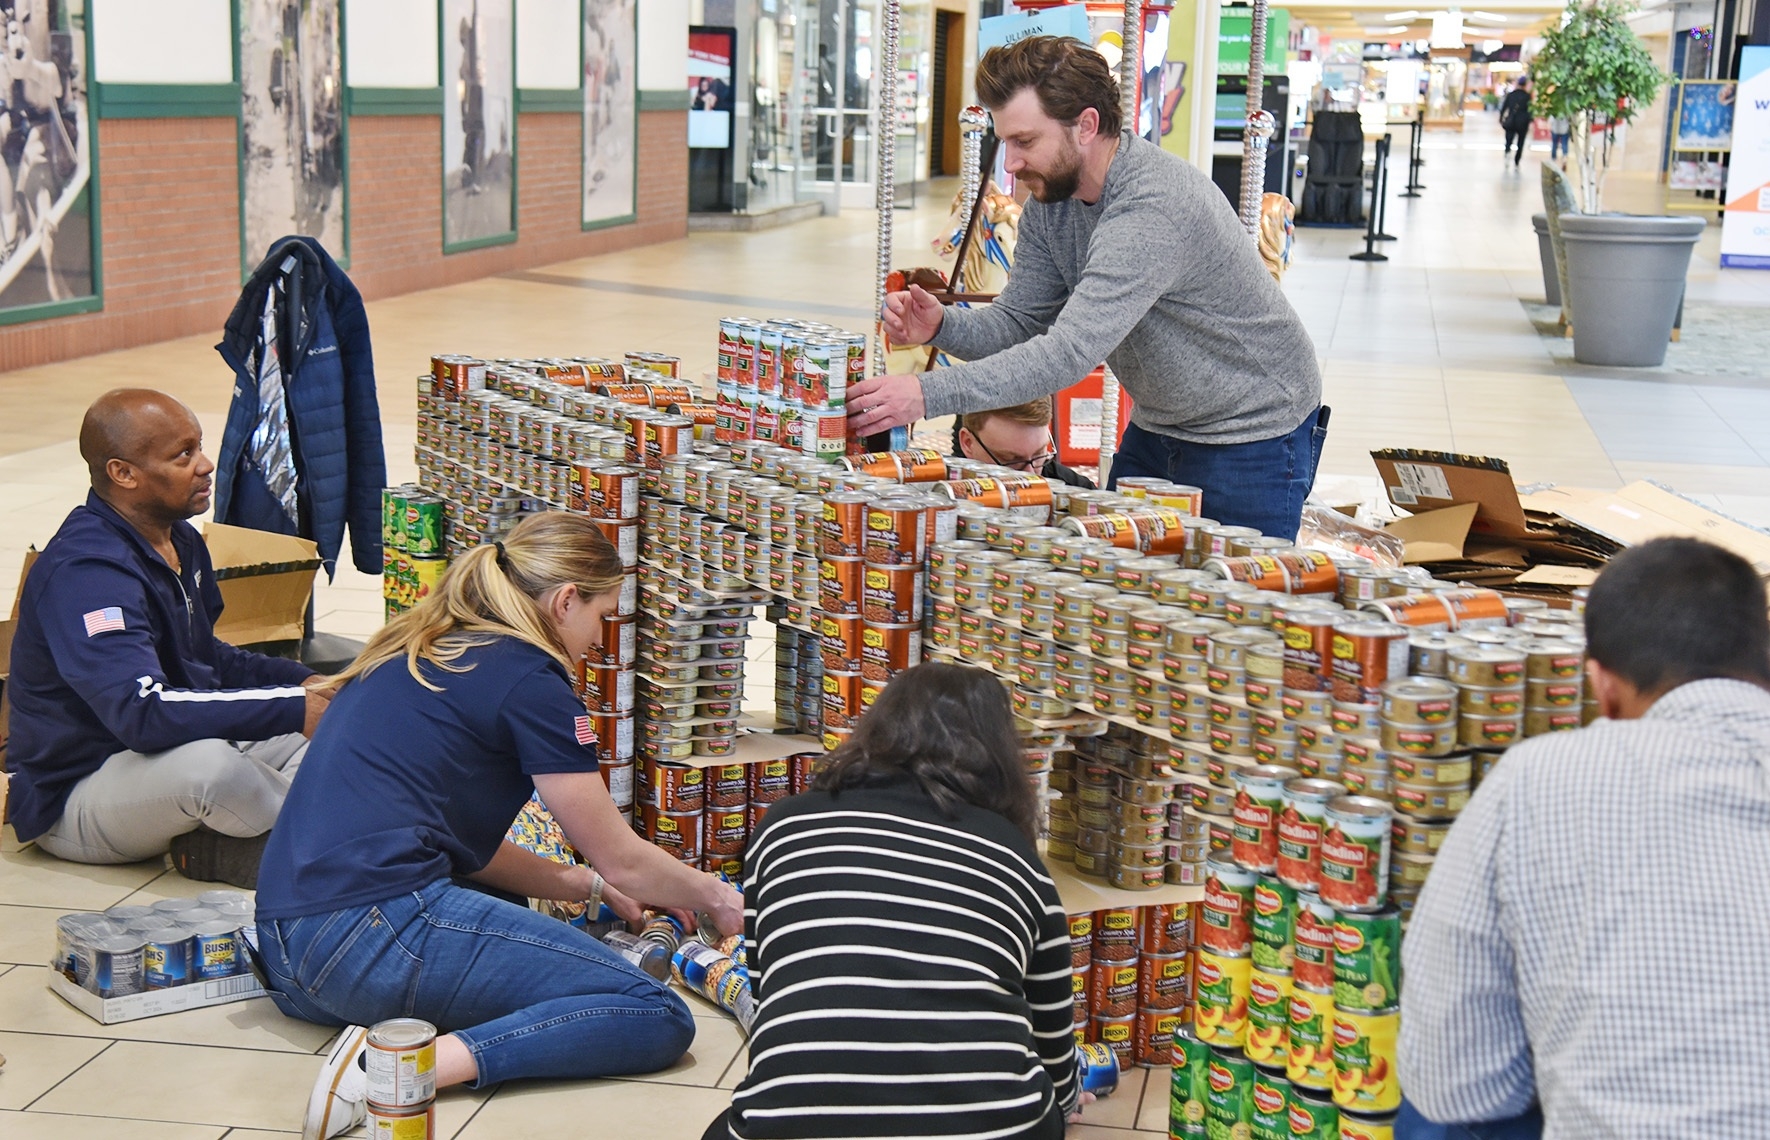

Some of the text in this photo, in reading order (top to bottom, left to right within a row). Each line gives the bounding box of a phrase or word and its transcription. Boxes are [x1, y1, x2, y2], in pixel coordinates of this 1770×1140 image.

[1106, 915, 1131, 924] BUSH'S
[205, 941, 235, 954] BUSH'S
[1105, 1028, 1128, 1036] BUSH'S
